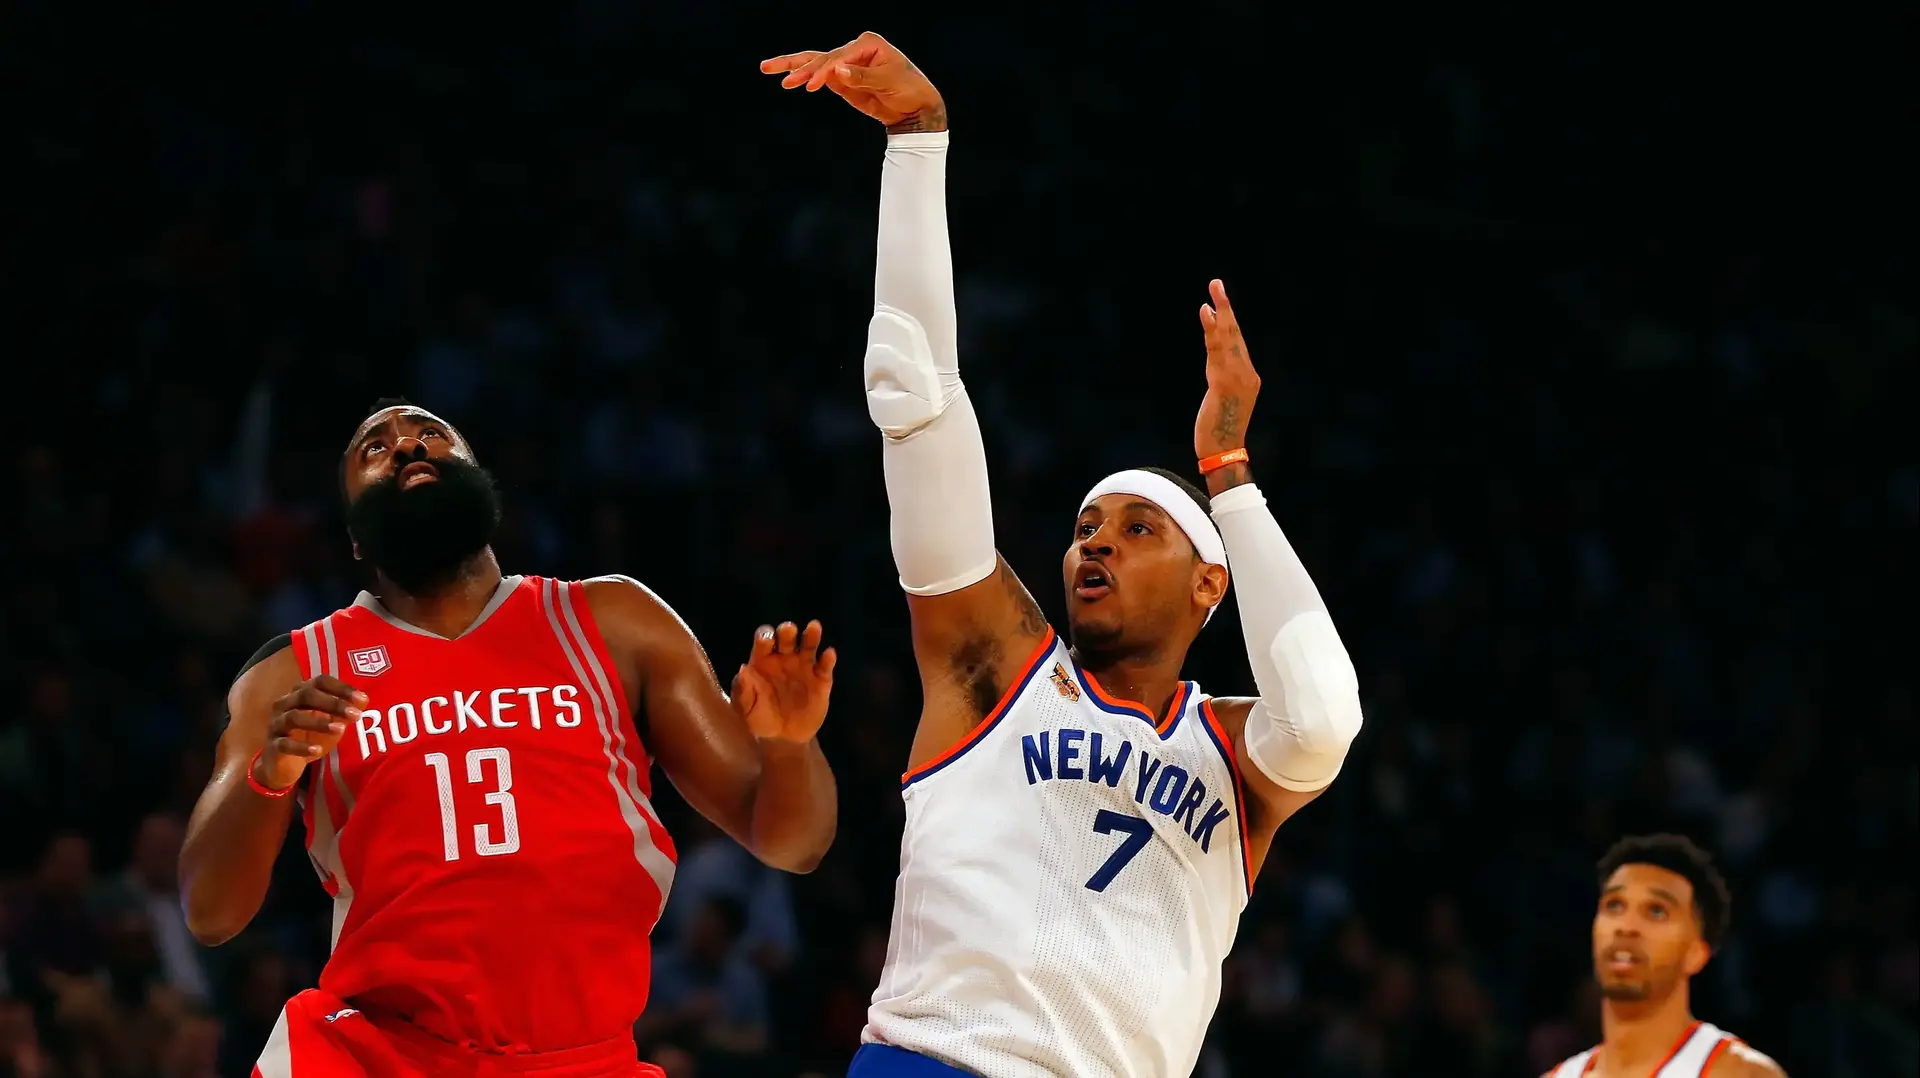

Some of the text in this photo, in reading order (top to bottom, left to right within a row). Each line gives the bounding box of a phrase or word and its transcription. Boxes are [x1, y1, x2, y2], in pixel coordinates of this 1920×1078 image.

[356, 651, 382, 666] 50
[355, 684, 582, 760] ROCKETS
[424, 747, 520, 862] 13
[1022, 728, 1230, 854] NEW YORK
[1084, 808, 1155, 893] 7
